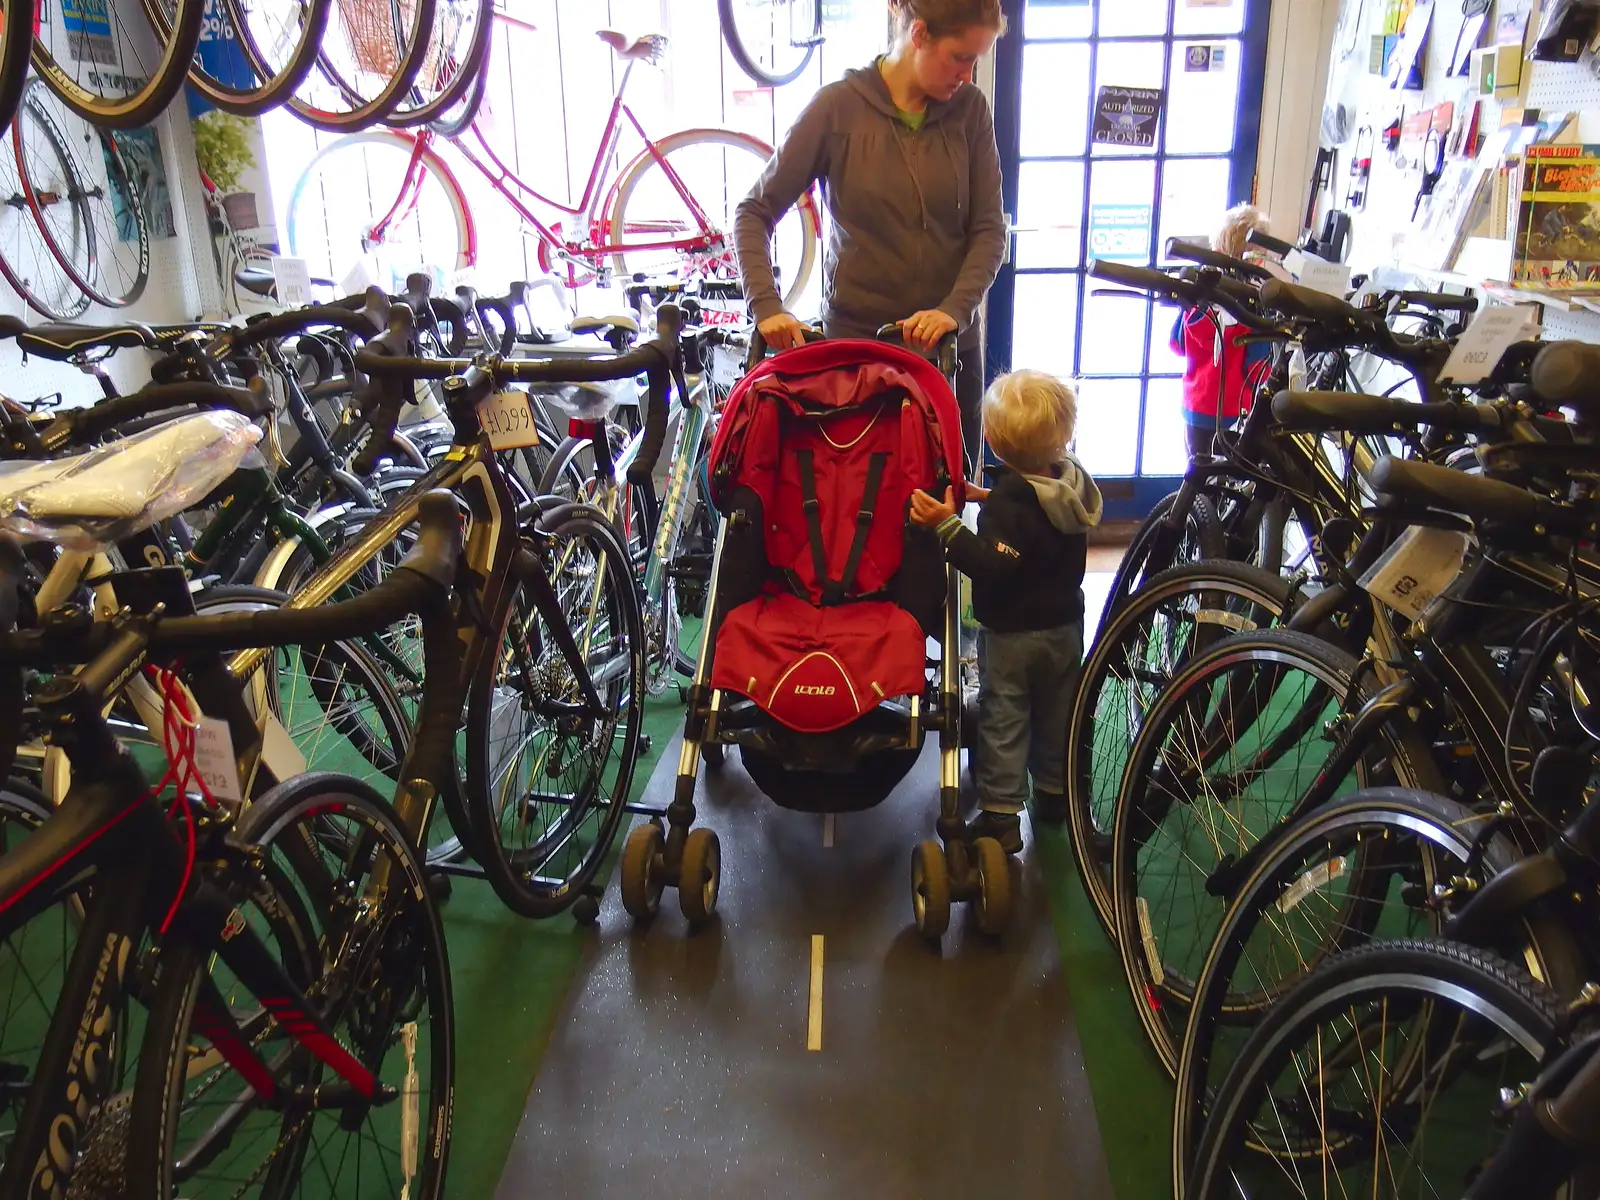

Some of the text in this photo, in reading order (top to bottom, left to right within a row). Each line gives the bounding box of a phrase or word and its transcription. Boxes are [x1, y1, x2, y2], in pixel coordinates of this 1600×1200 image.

[1101, 102, 1155, 114] AUTHORIZED
[1095, 129, 1152, 145] CLOSED
[129, 181, 149, 276] REYNOLDS
[66, 931, 118, 1075] TRIESTINA
